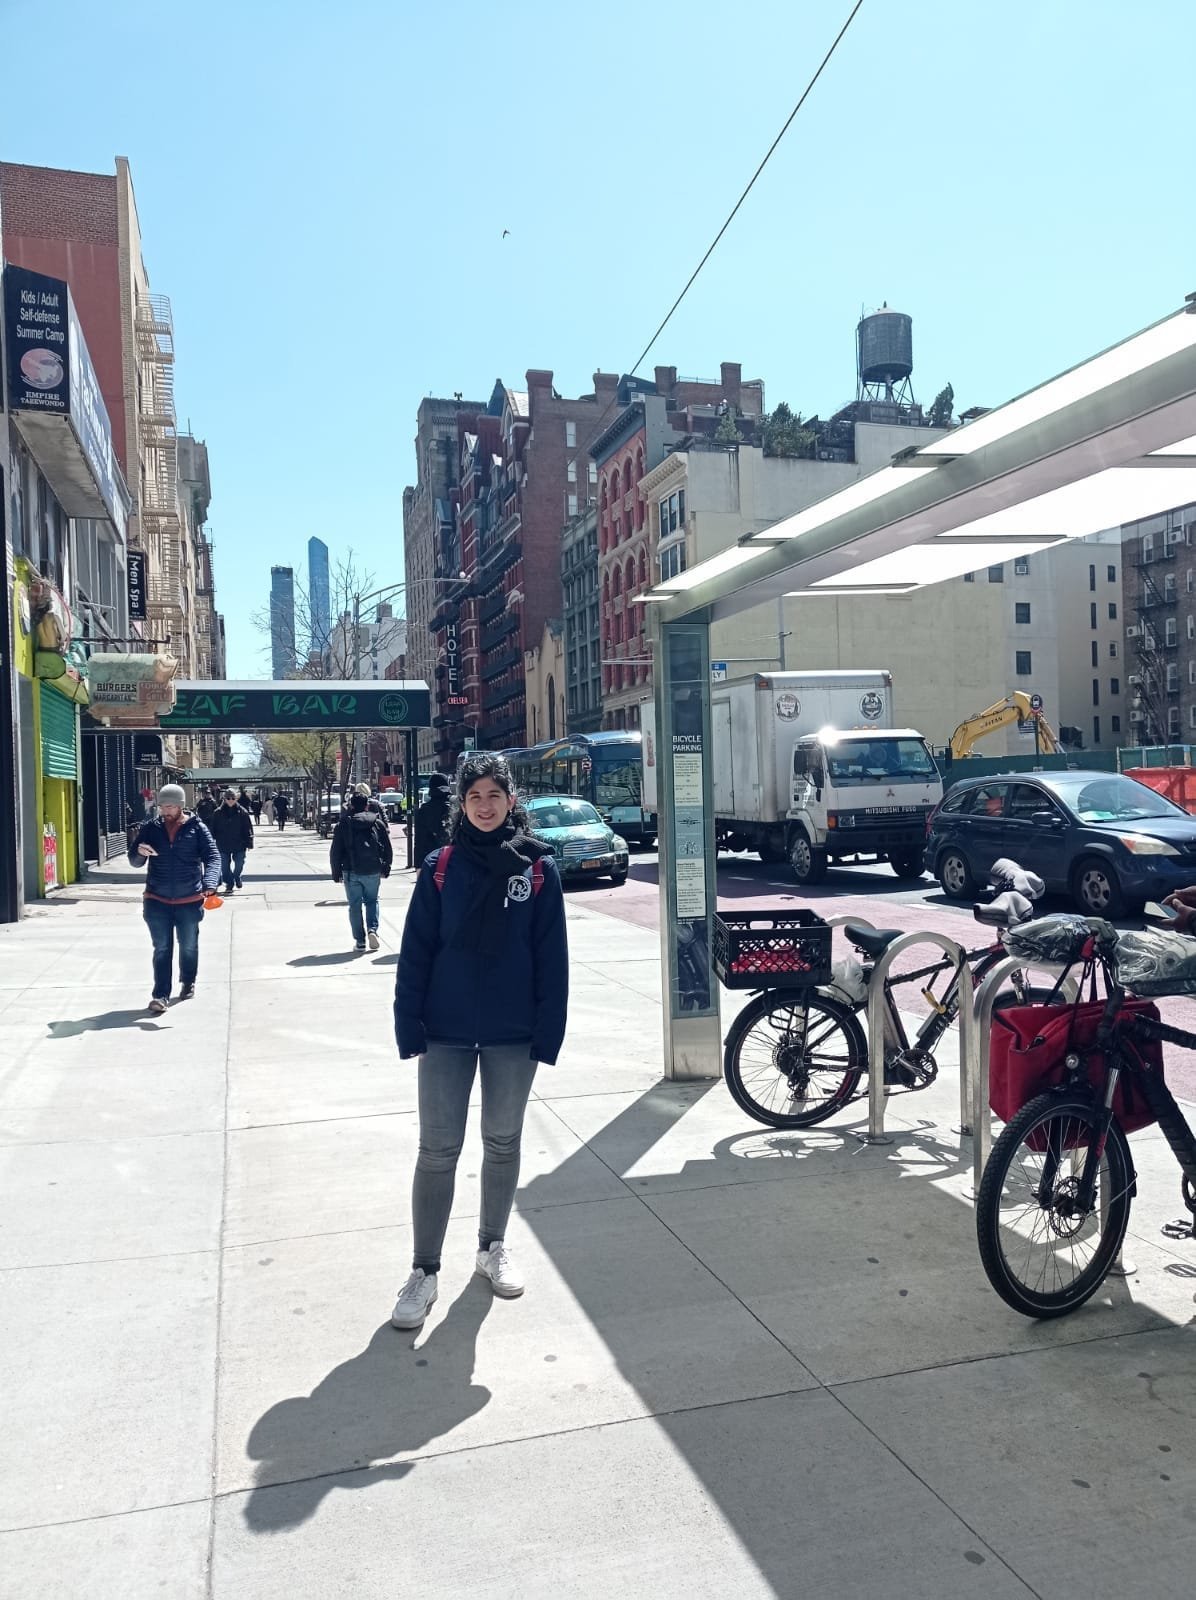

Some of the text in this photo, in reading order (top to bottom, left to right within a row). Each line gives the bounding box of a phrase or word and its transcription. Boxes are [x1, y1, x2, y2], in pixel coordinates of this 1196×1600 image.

[21, 289, 36, 305] Kids
[41, 292, 59, 307] Adult
[20, 307, 60, 324] Self-defense
[16, 324, 65, 345] Summer Camp
[25, 391, 60, 401] EMPIRE
[129, 588, 140, 609] Spa
[446, 624, 458, 696] HOTEL
[97, 683, 136, 692] BURGERS
[175, 694, 247, 716] EAF
[272, 694, 357, 716] BAR
[672, 735, 702, 743] BICYCLE
[672, 744, 702, 752] PARKING
[865, 806, 900, 815] MITSUBISHI
